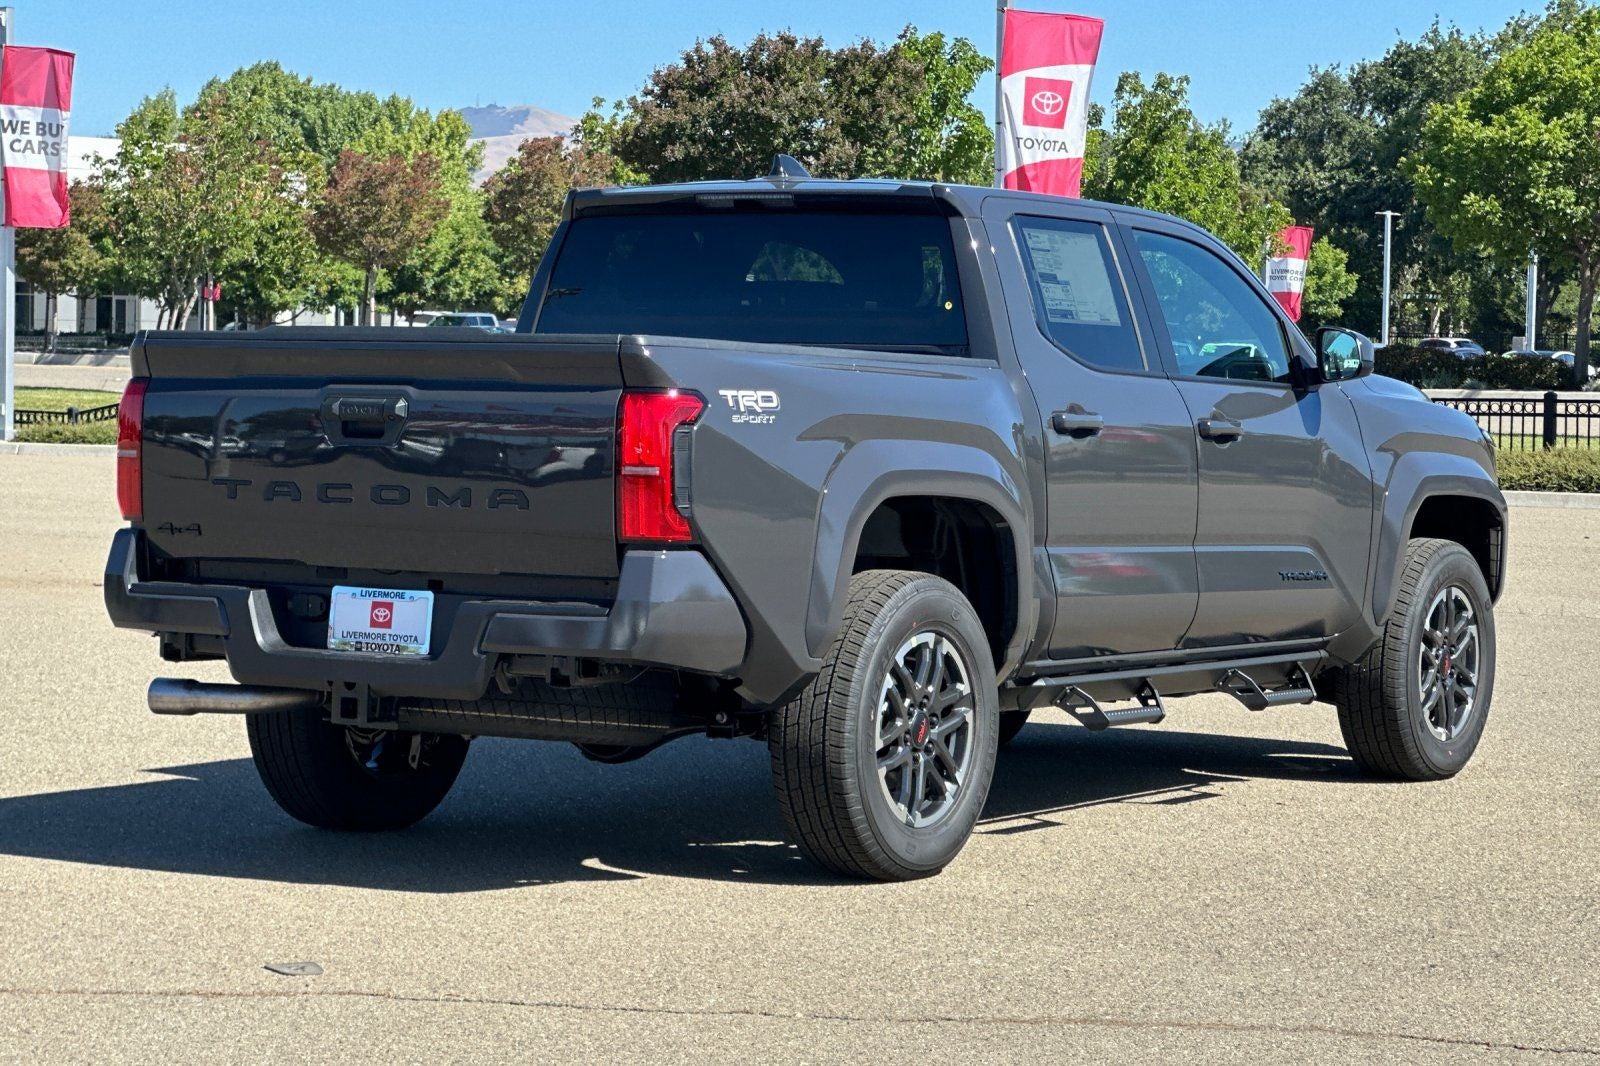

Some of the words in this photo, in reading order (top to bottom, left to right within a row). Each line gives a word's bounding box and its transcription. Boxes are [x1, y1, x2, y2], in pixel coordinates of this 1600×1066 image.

[1, 119, 30, 135] WE
[9, 139, 60, 157] CARS
[1016, 136, 1068, 153] TOYOTA
[718, 389, 779, 412] TRD
[731, 414, 776, 424] SPORT
[211, 478, 531, 511] TACOMA
[360, 589, 406, 600] LIVERMORE
[341, 630, 387, 641] LIVERMORE
[387, 634, 419, 644] TOYOTA
[365, 641, 401, 653] TOYOTA
